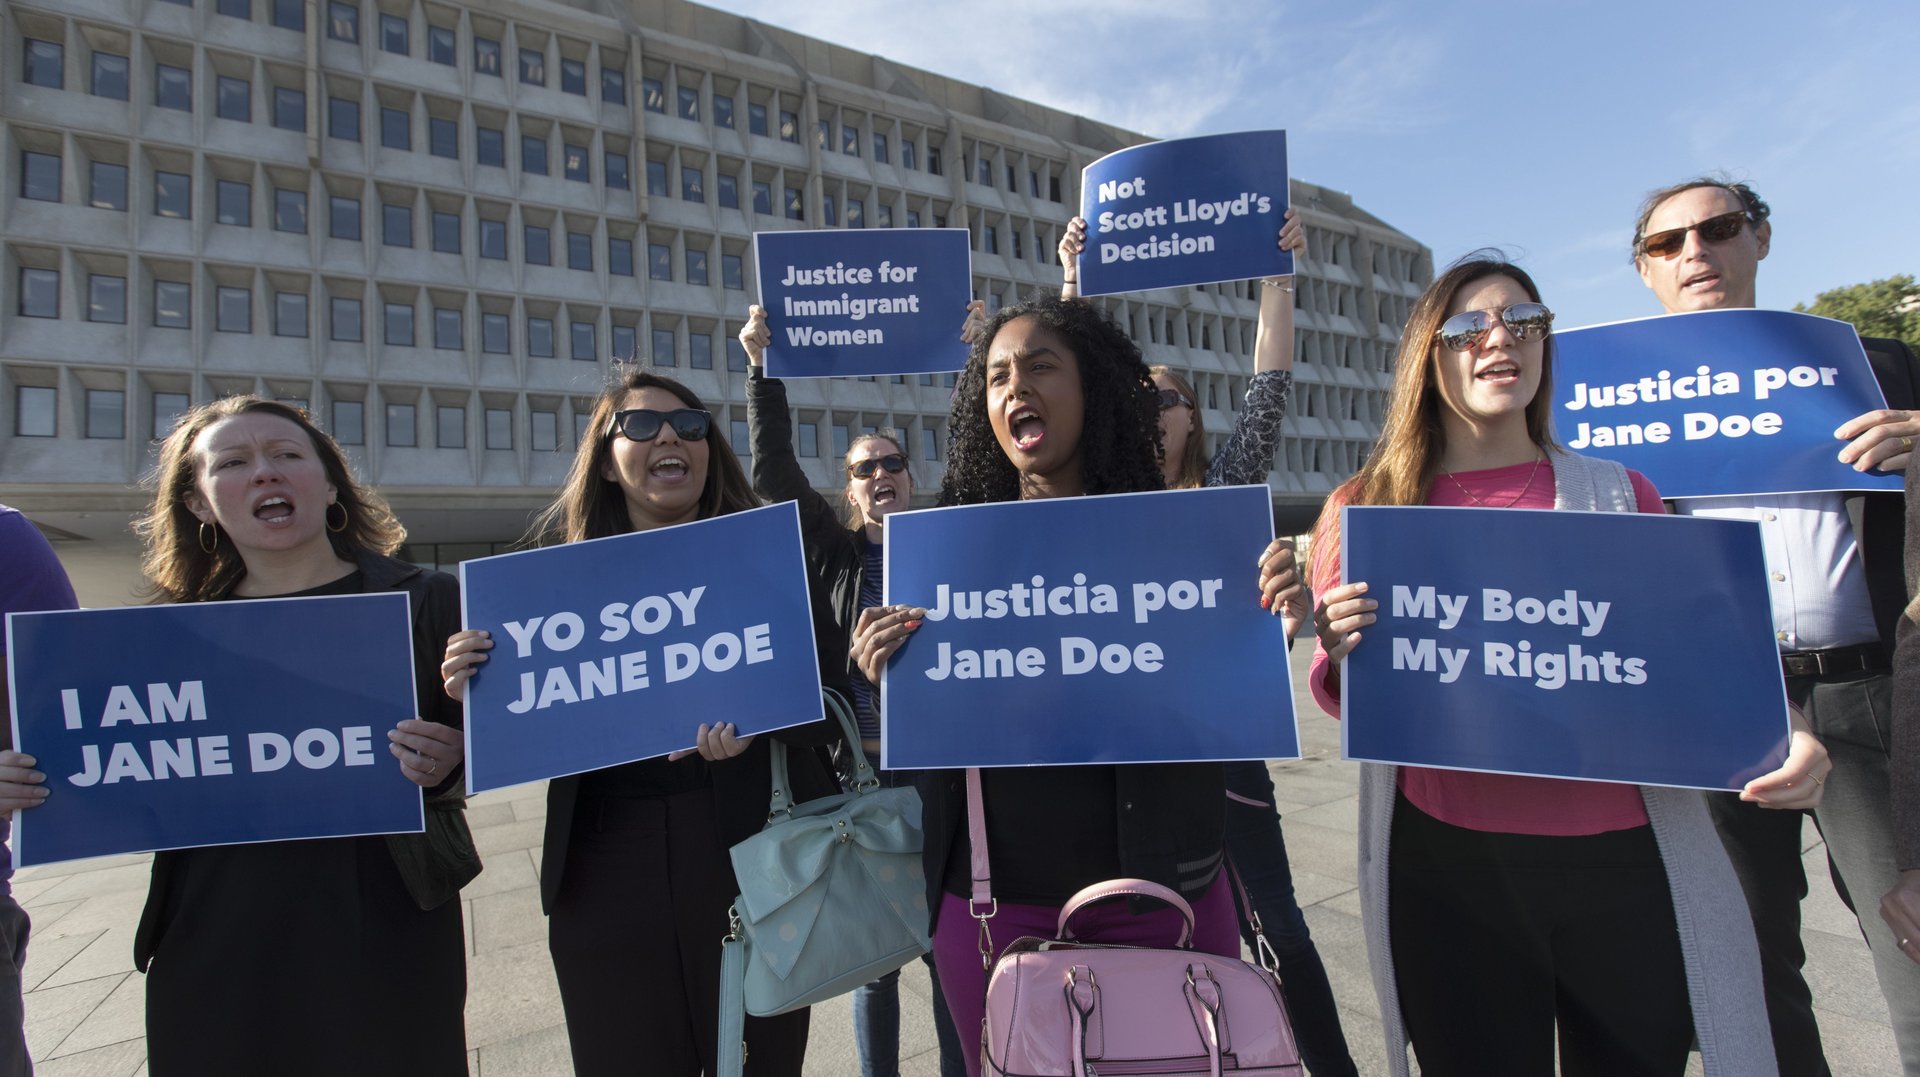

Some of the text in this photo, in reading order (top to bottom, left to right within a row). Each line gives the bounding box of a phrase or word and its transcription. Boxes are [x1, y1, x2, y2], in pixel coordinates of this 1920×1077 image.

[1098, 176, 1146, 203] Not
[1098, 192, 1271, 233] Scott Lloyd's
[1101, 233, 1215, 264] Decision
[781, 260, 918, 287] Justice for
[784, 292, 920, 321] Immigrant
[785, 326, 884, 347] Women
[1565, 365, 1839, 410] Justicia por
[1568, 412, 1784, 449] Jane Doe
[926, 573, 1223, 624] Justicia por
[1393, 586, 1611, 636] My Body
[503, 586, 707, 657] YO SOY
[507, 623, 774, 713] JANE DOE
[925, 637, 1164, 681] Jane Doe
[1393, 638, 1648, 690] My Rights
[62, 681, 207, 729] I AM
[69, 726, 375, 786] JANE DOE
